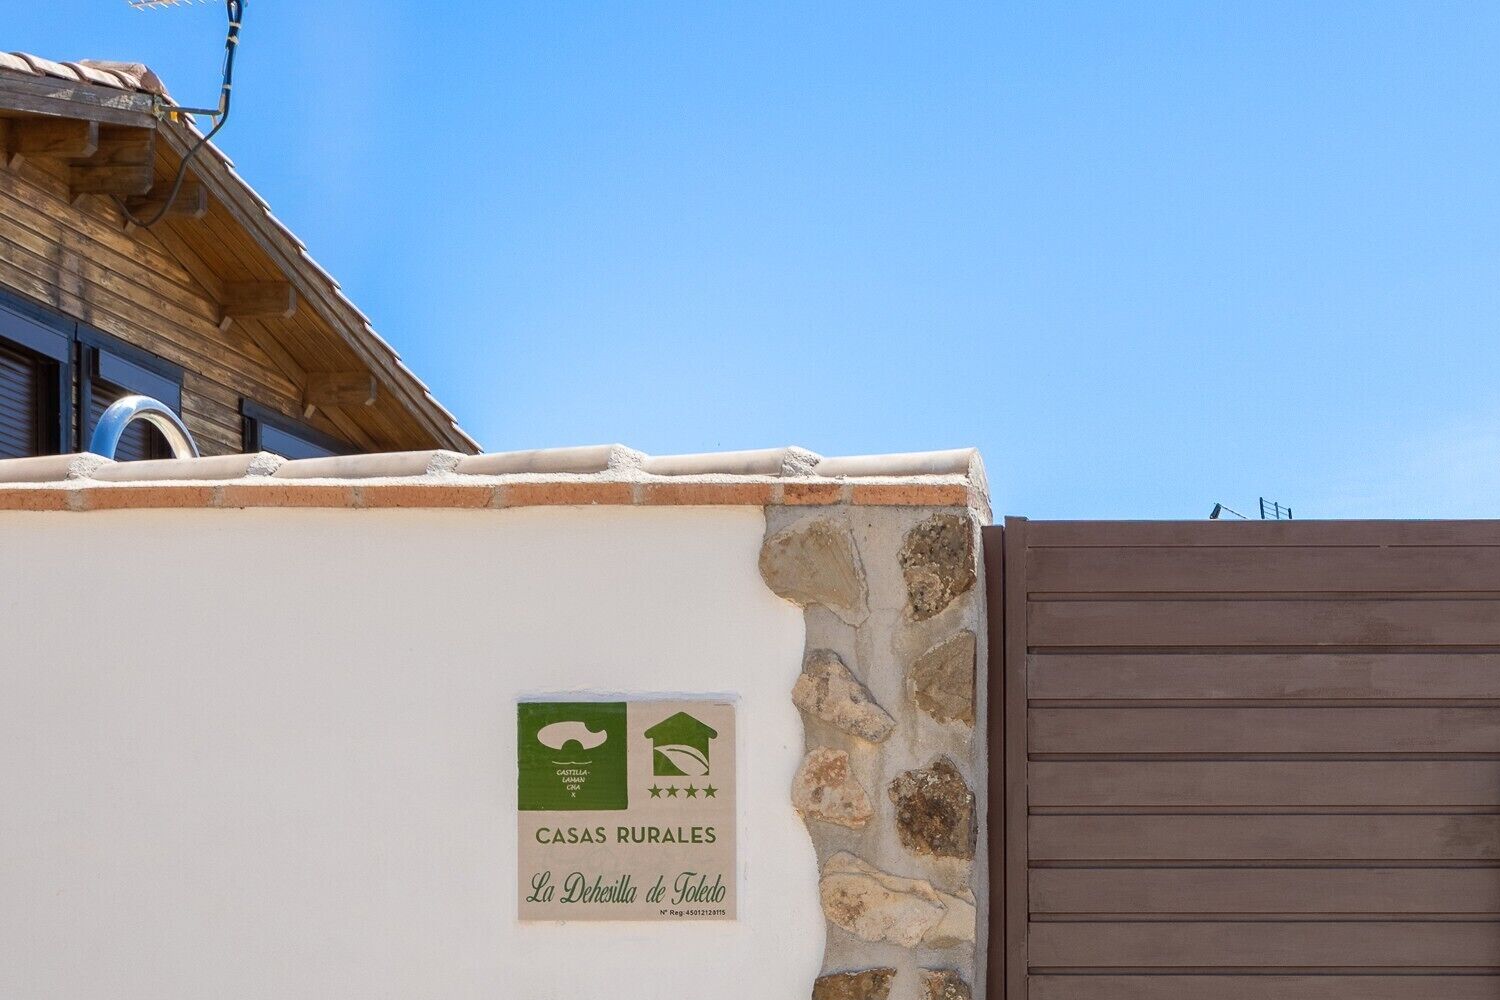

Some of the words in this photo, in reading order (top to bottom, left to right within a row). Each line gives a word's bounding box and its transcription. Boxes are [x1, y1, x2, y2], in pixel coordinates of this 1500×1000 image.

[536, 827, 607, 844] CASAS
[617, 826, 717, 844] RURALES
[526, 871, 555, 903] La
[560, 871, 637, 904] Dehesilla
[646, 874, 667, 903] de
[671, 871, 726, 905] Toledo
